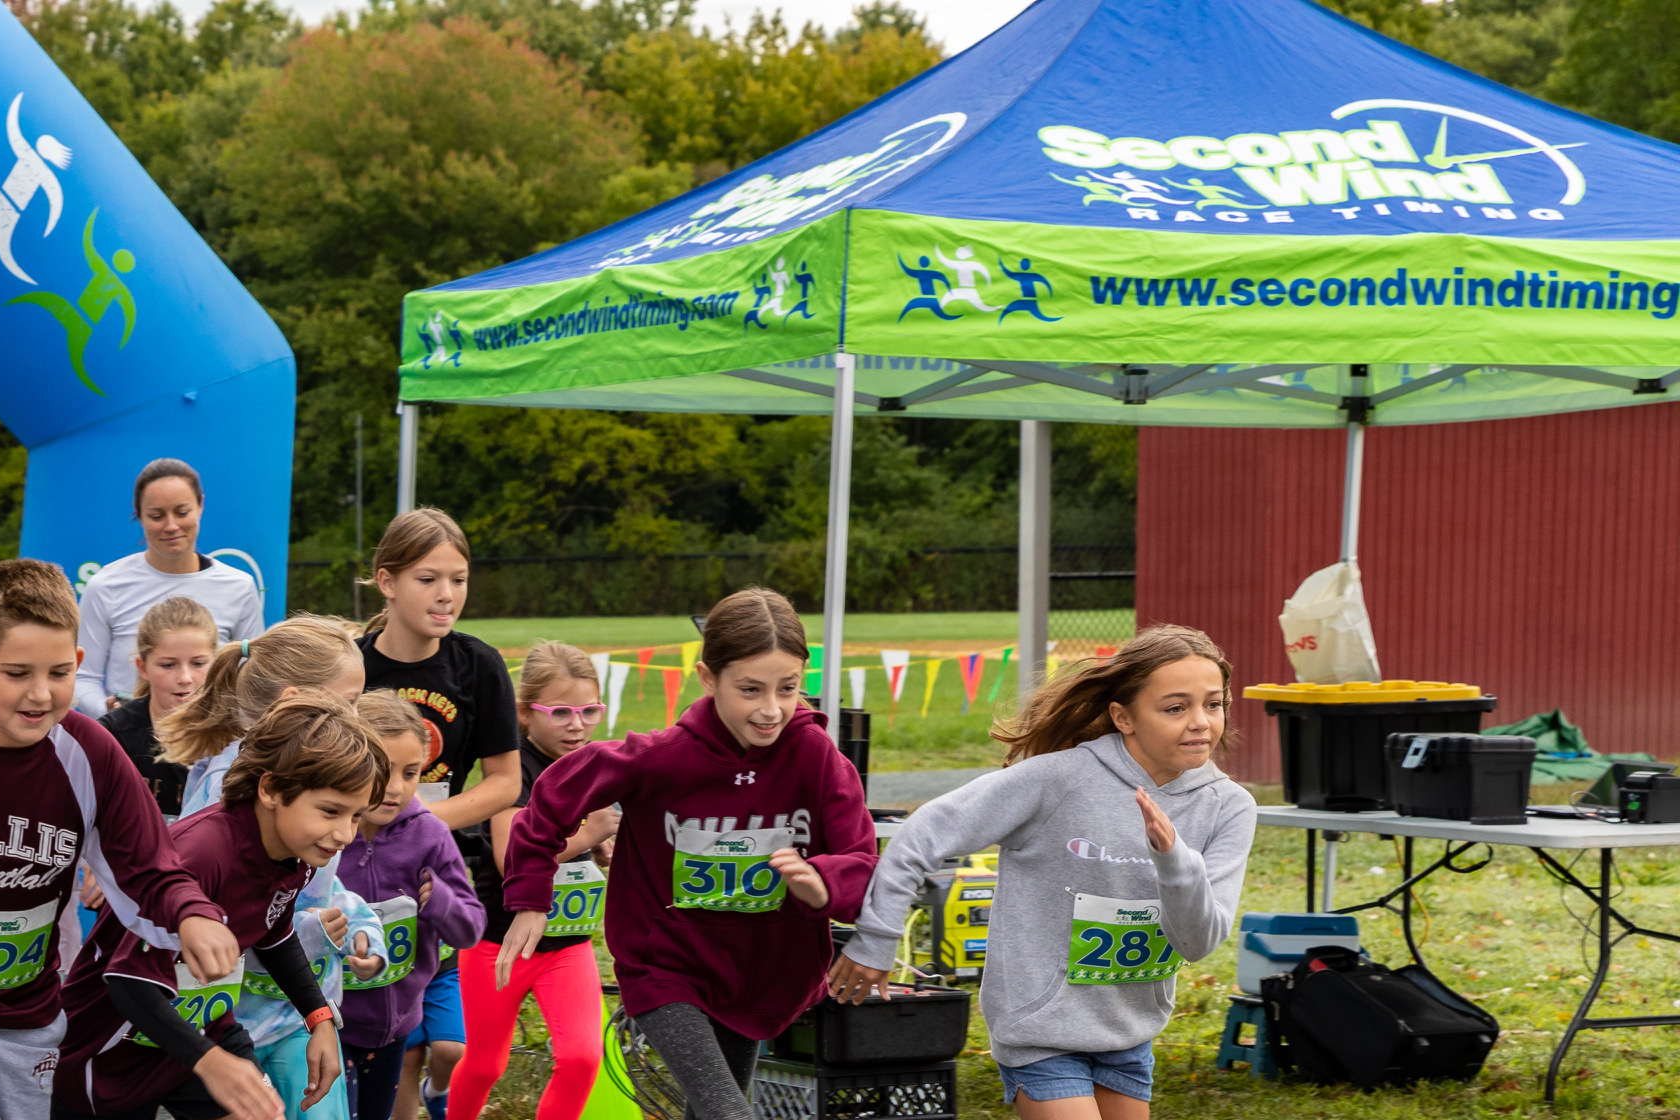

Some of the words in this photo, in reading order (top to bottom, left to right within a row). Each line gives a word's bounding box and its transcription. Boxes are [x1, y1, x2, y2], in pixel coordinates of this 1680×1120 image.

[1037, 119, 1419, 169] Second
[1234, 161, 1513, 206] Wind
[1126, 207, 1294, 222] RACE
[1332, 200, 1565, 221] TIMING
[1090, 267, 1680, 319] www.secondwindtiming
[473, 288, 739, 352] www.secondwindtiming.com
[397, 687, 428, 704] ACK
[427, 691, 458, 722] KEYS
[419, 762, 450, 783] OGIE
[1067, 838, 1156, 865] Cham
[681, 859, 783, 898] 310
[1076, 927, 1175, 968] 287
